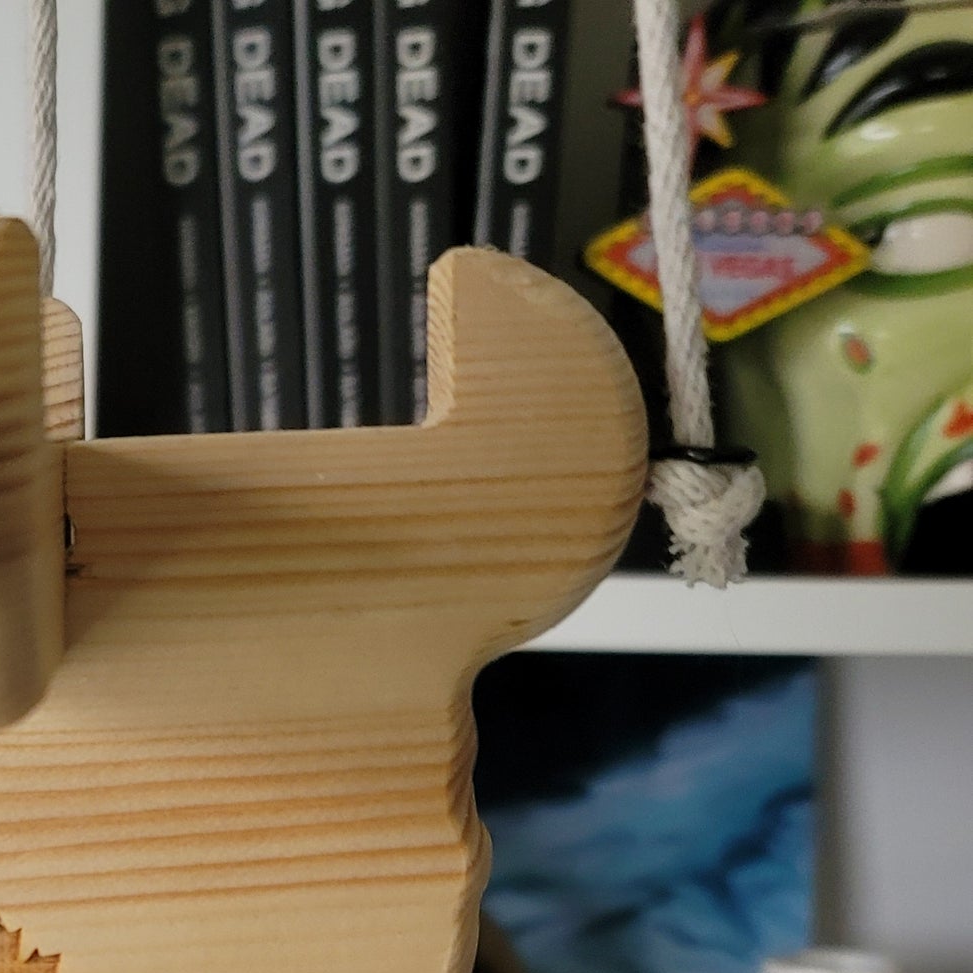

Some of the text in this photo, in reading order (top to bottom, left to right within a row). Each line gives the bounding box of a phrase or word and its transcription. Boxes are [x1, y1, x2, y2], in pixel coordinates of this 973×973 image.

[157, 36, 200, 186] DEAD
[232, 27, 276, 183] DEAD
[317, 28, 360, 184] DEAD
[395, 27, 438, 184] DEAD
[503, 27, 553, 185] DEAD
